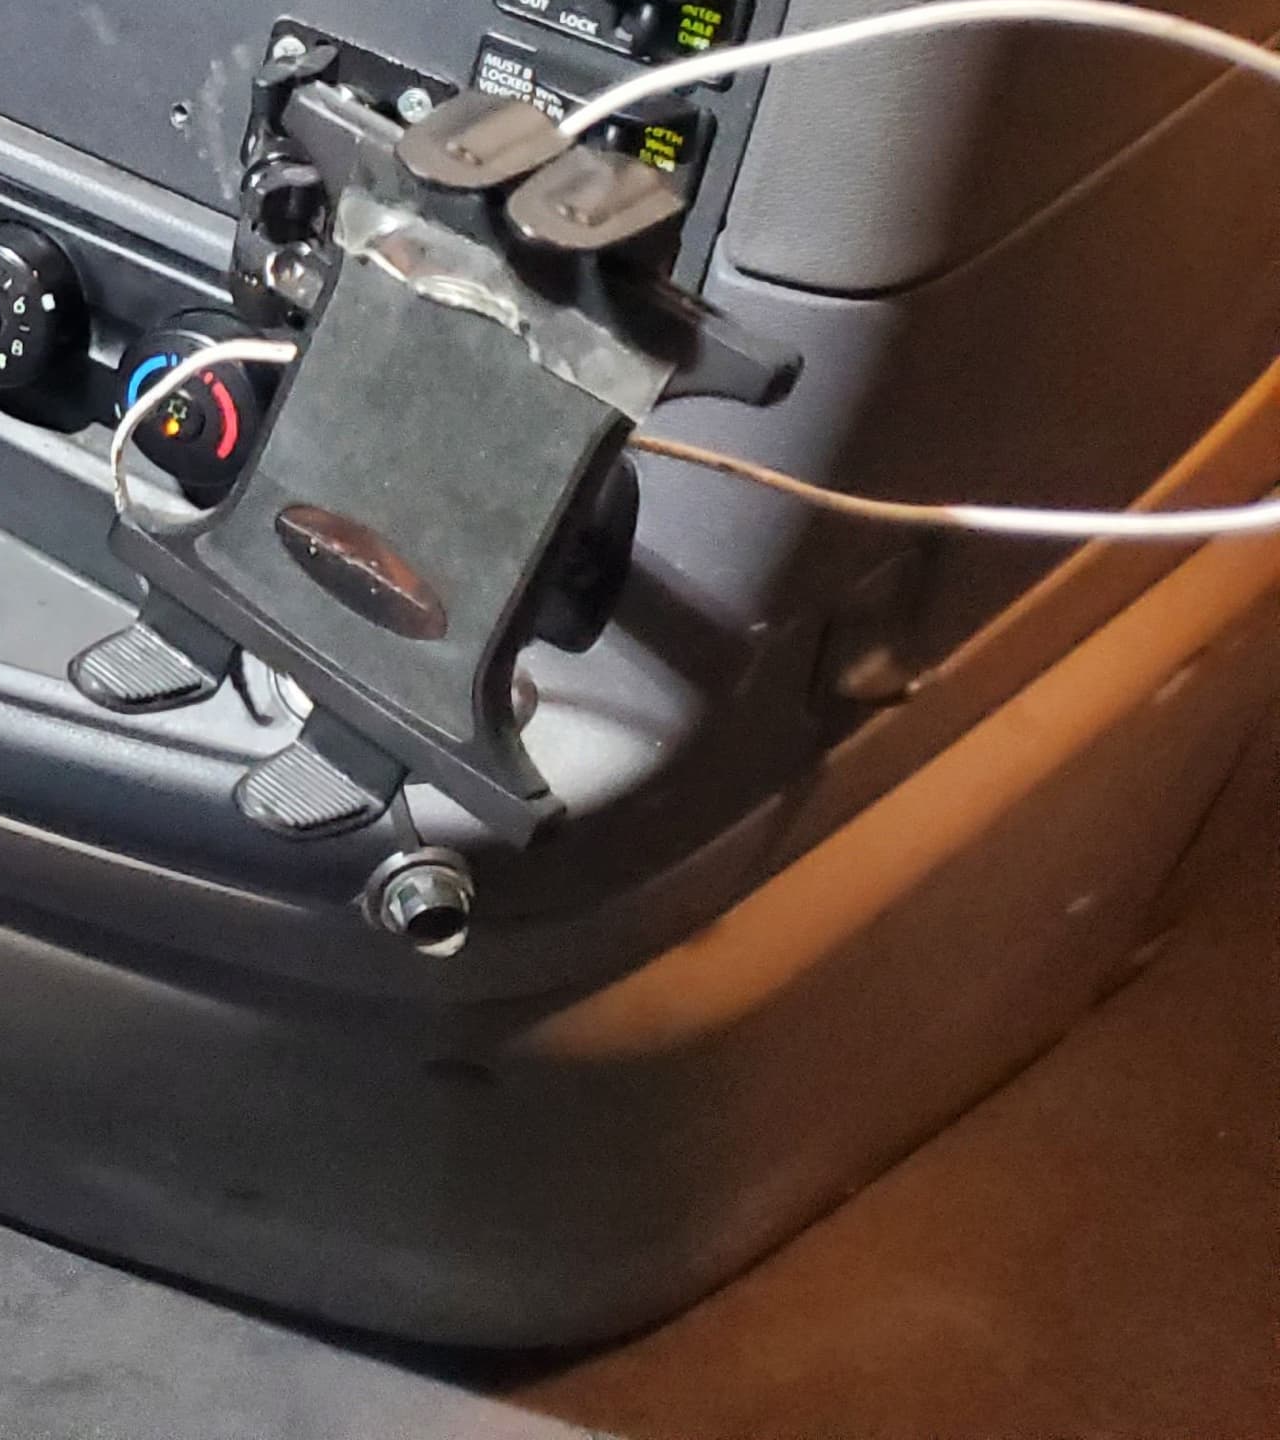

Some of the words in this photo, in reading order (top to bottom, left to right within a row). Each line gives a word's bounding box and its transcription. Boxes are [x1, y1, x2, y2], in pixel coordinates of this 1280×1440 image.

[559, 11, 599, 35] LOCK
[483, 53, 523, 75] MUST
[523, 67, 533, 80] B
[481, 65, 533, 93] LOCKED
[13, 296, 25, 314] 6
[11, 339, 23, 356] 8
